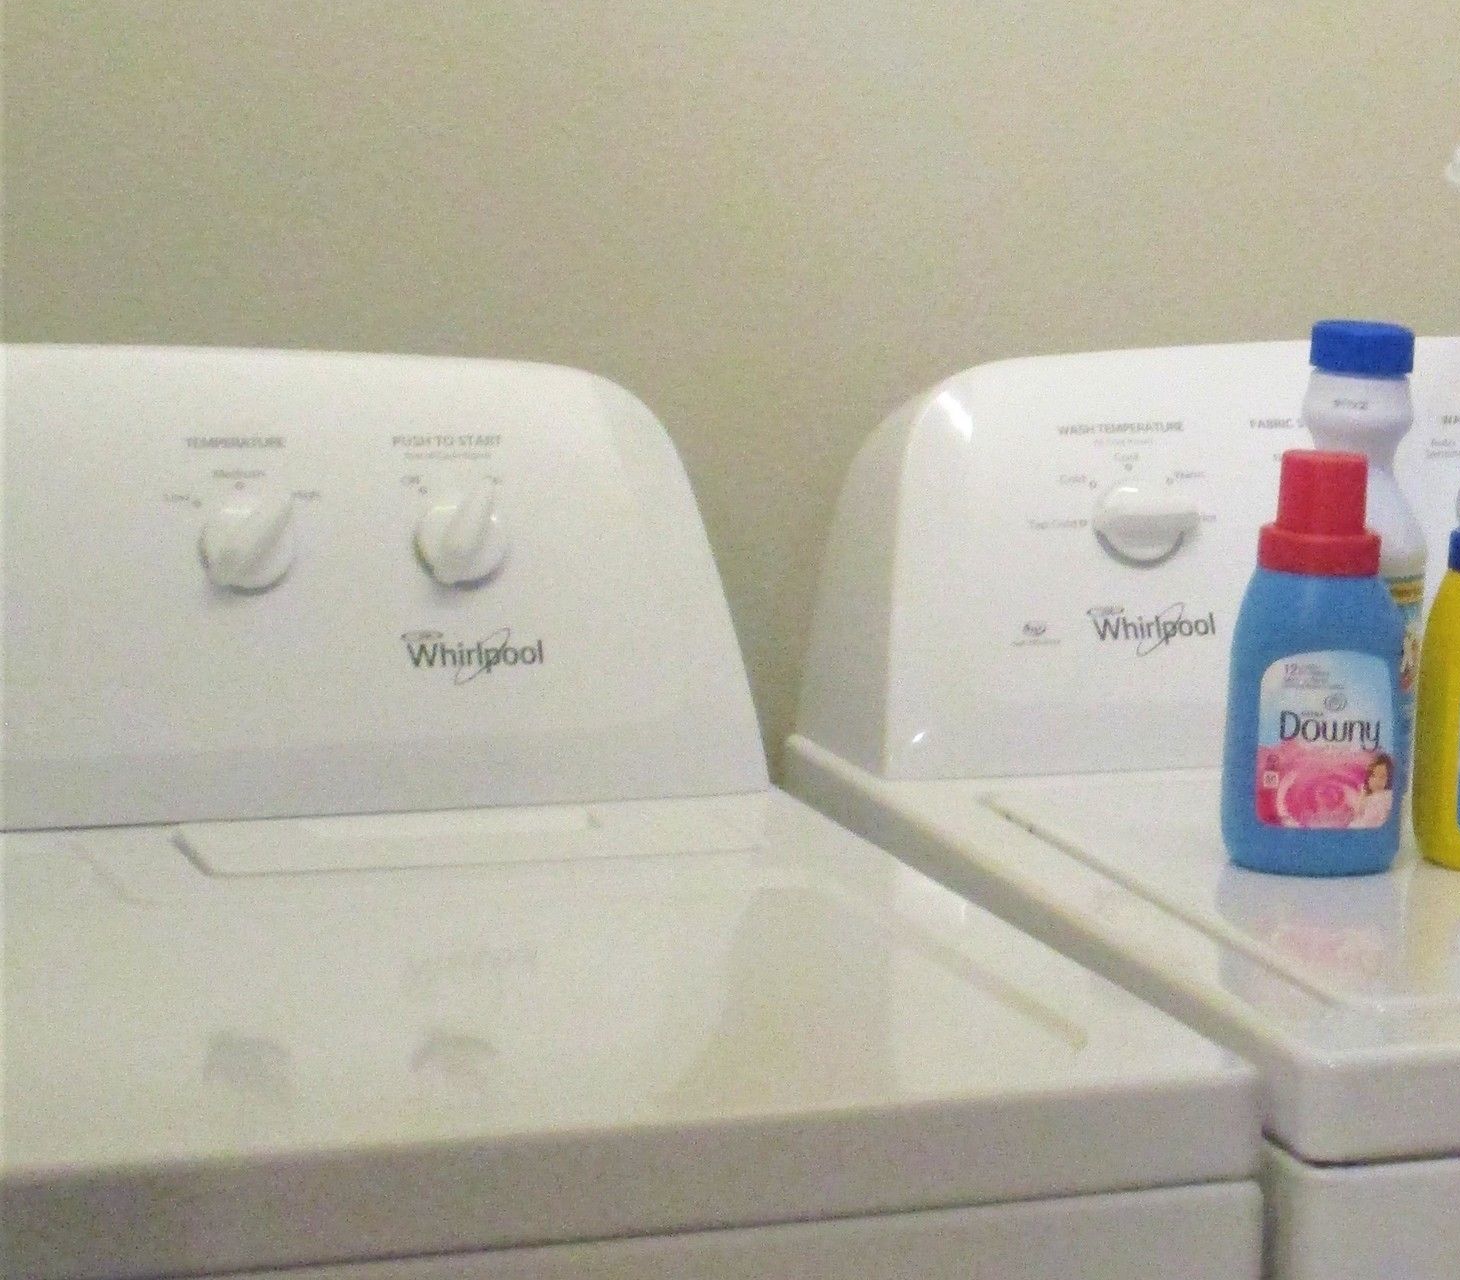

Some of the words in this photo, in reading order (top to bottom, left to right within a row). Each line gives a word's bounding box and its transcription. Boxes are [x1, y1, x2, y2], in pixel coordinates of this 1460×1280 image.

[391, 434, 432, 448] PUSH
[434, 433, 455, 448] TO
[457, 433, 503, 448] START
[1097, 420, 1185, 435] TEMPERATURE
[185, 435, 286, 450] TEMPERATURE
[1090, 610, 1217, 647] Whirlpool
[406, 637, 545, 675] Whirlpool
[1279, 709, 1381, 752] Downy
